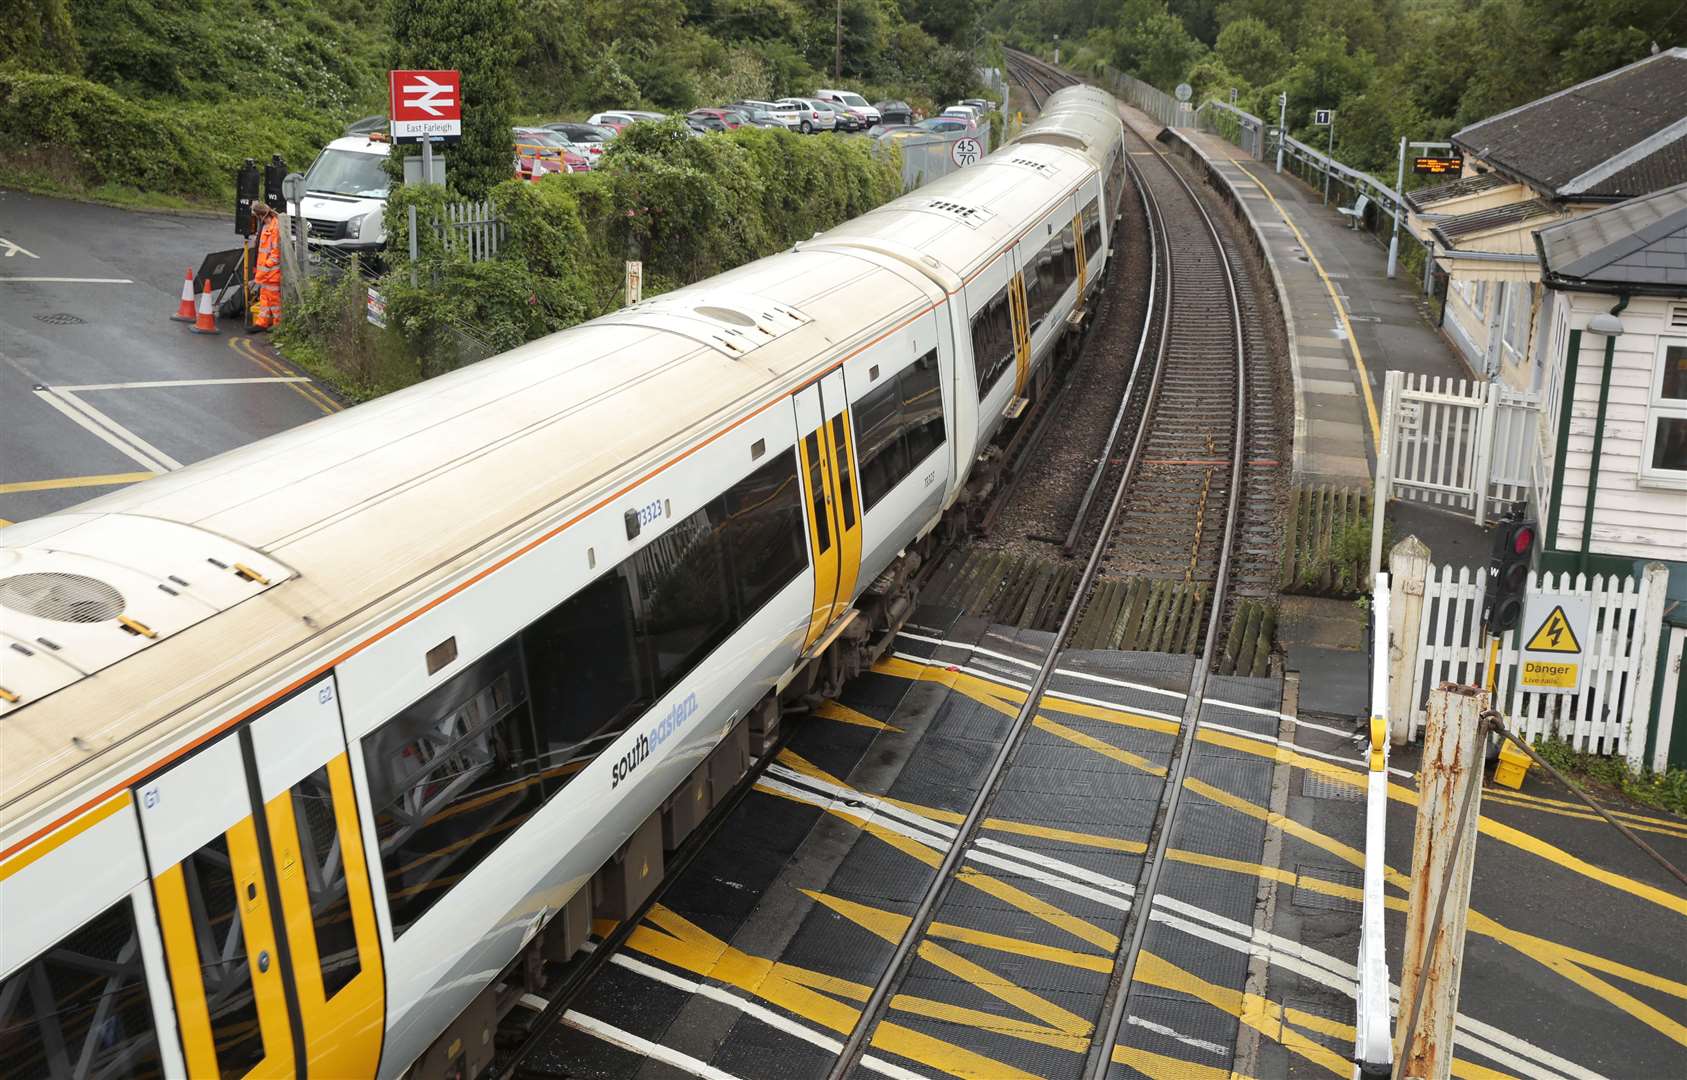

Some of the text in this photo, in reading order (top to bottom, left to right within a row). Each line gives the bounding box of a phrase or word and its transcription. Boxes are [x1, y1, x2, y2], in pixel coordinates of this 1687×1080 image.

[1320, 112, 1325, 122] 1
[407, 122, 453, 133] East Farleigh
[958, 140, 975, 152] 45
[960, 154, 975, 168] 70
[1526, 663, 1570, 676] Danger
[319, 685, 333, 705] G2
[611, 691, 699, 790] southeastern
[144, 787, 160, 809] G1
